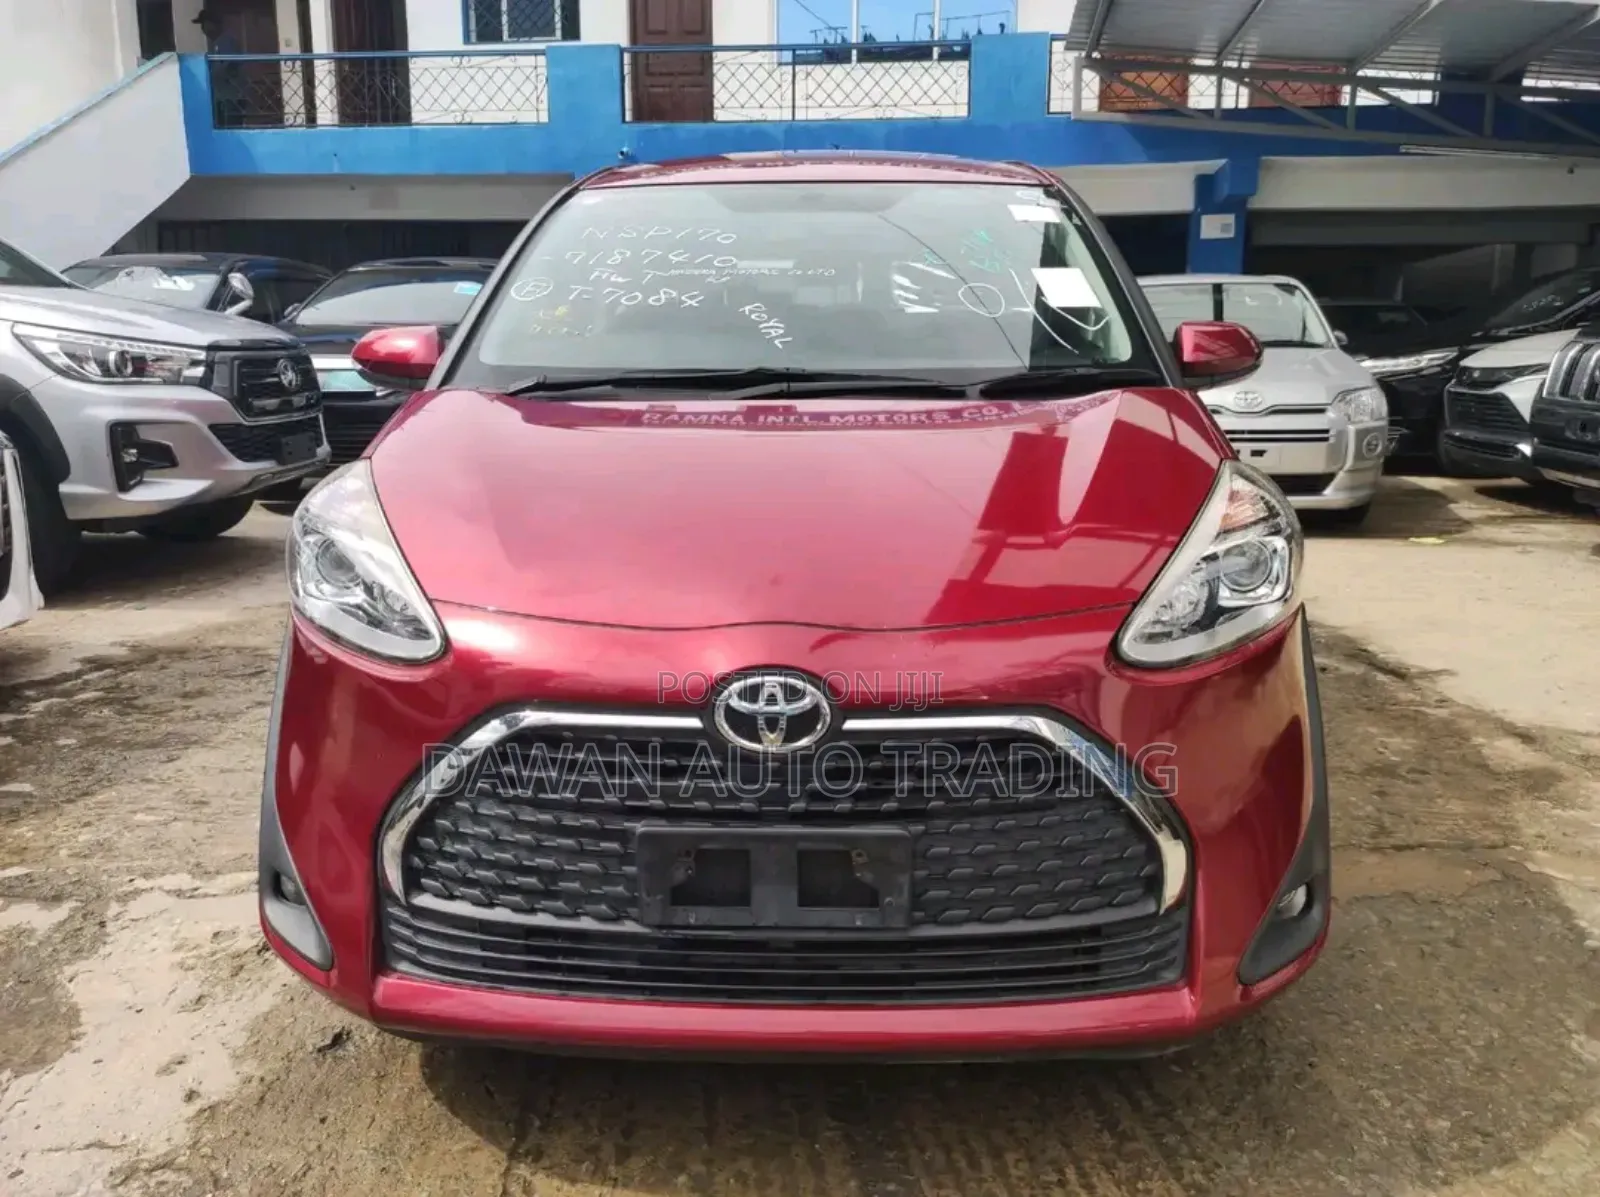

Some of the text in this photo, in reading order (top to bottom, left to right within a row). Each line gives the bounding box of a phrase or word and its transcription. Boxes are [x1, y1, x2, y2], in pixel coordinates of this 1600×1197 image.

[581, 225, 737, 244] NSP170
[738, 303, 794, 350] ROYAL
[828, 410, 950, 425] MOTORS
